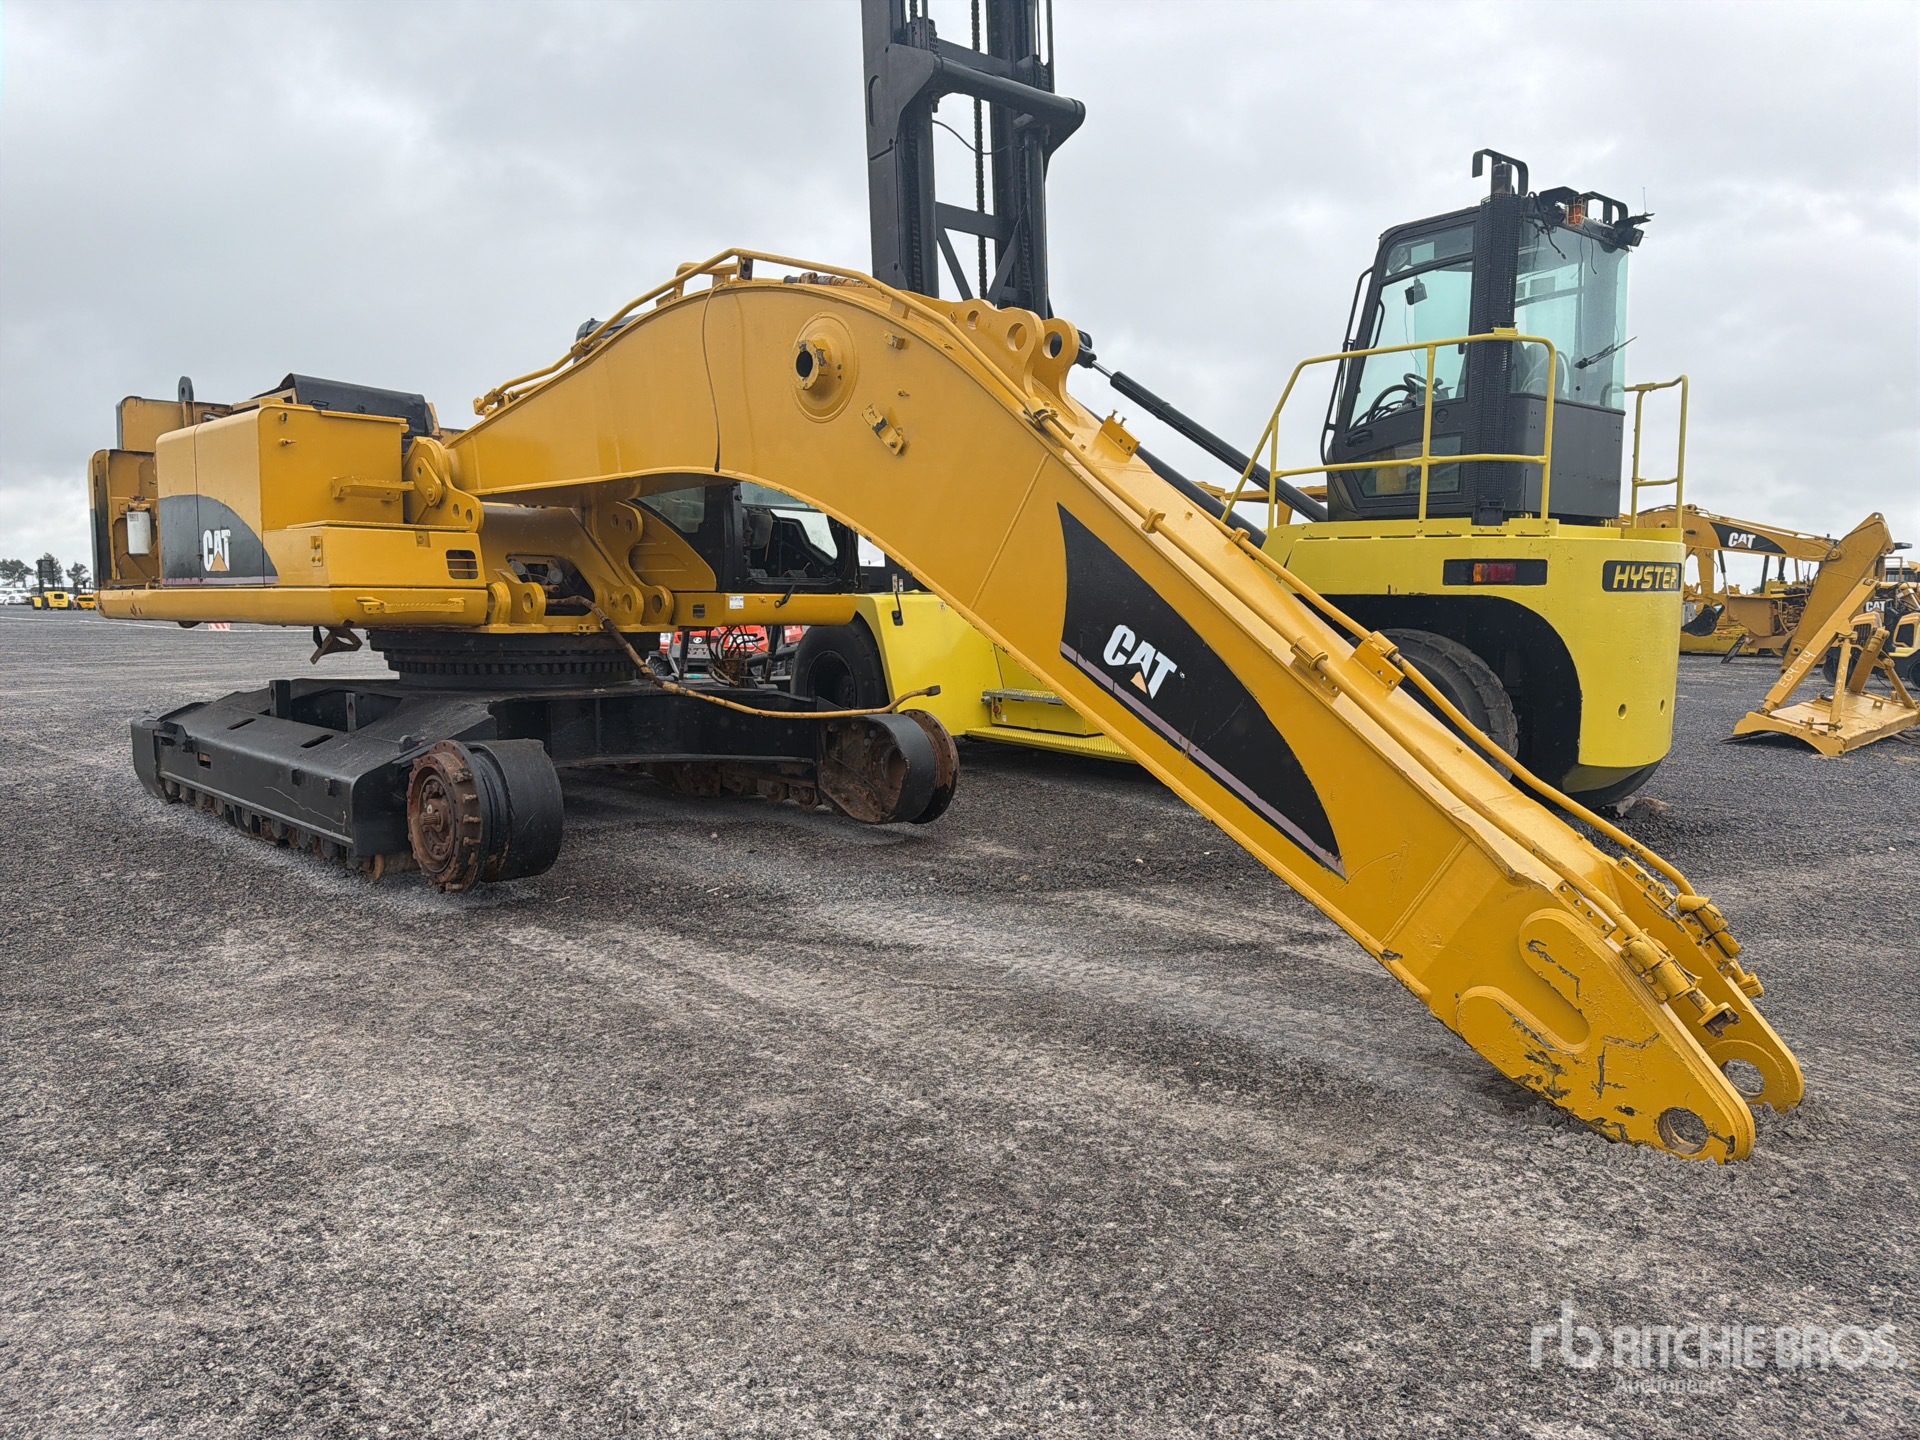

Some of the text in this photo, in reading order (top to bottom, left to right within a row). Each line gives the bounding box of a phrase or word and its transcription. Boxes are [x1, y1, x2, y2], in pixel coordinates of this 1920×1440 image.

[203, 529, 231, 572] CAT
[1728, 532, 1756, 549] CAT
[1612, 565, 1678, 589] HYSTER
[1865, 600, 1886, 612] CAT
[1103, 624, 1178, 700] CAT
